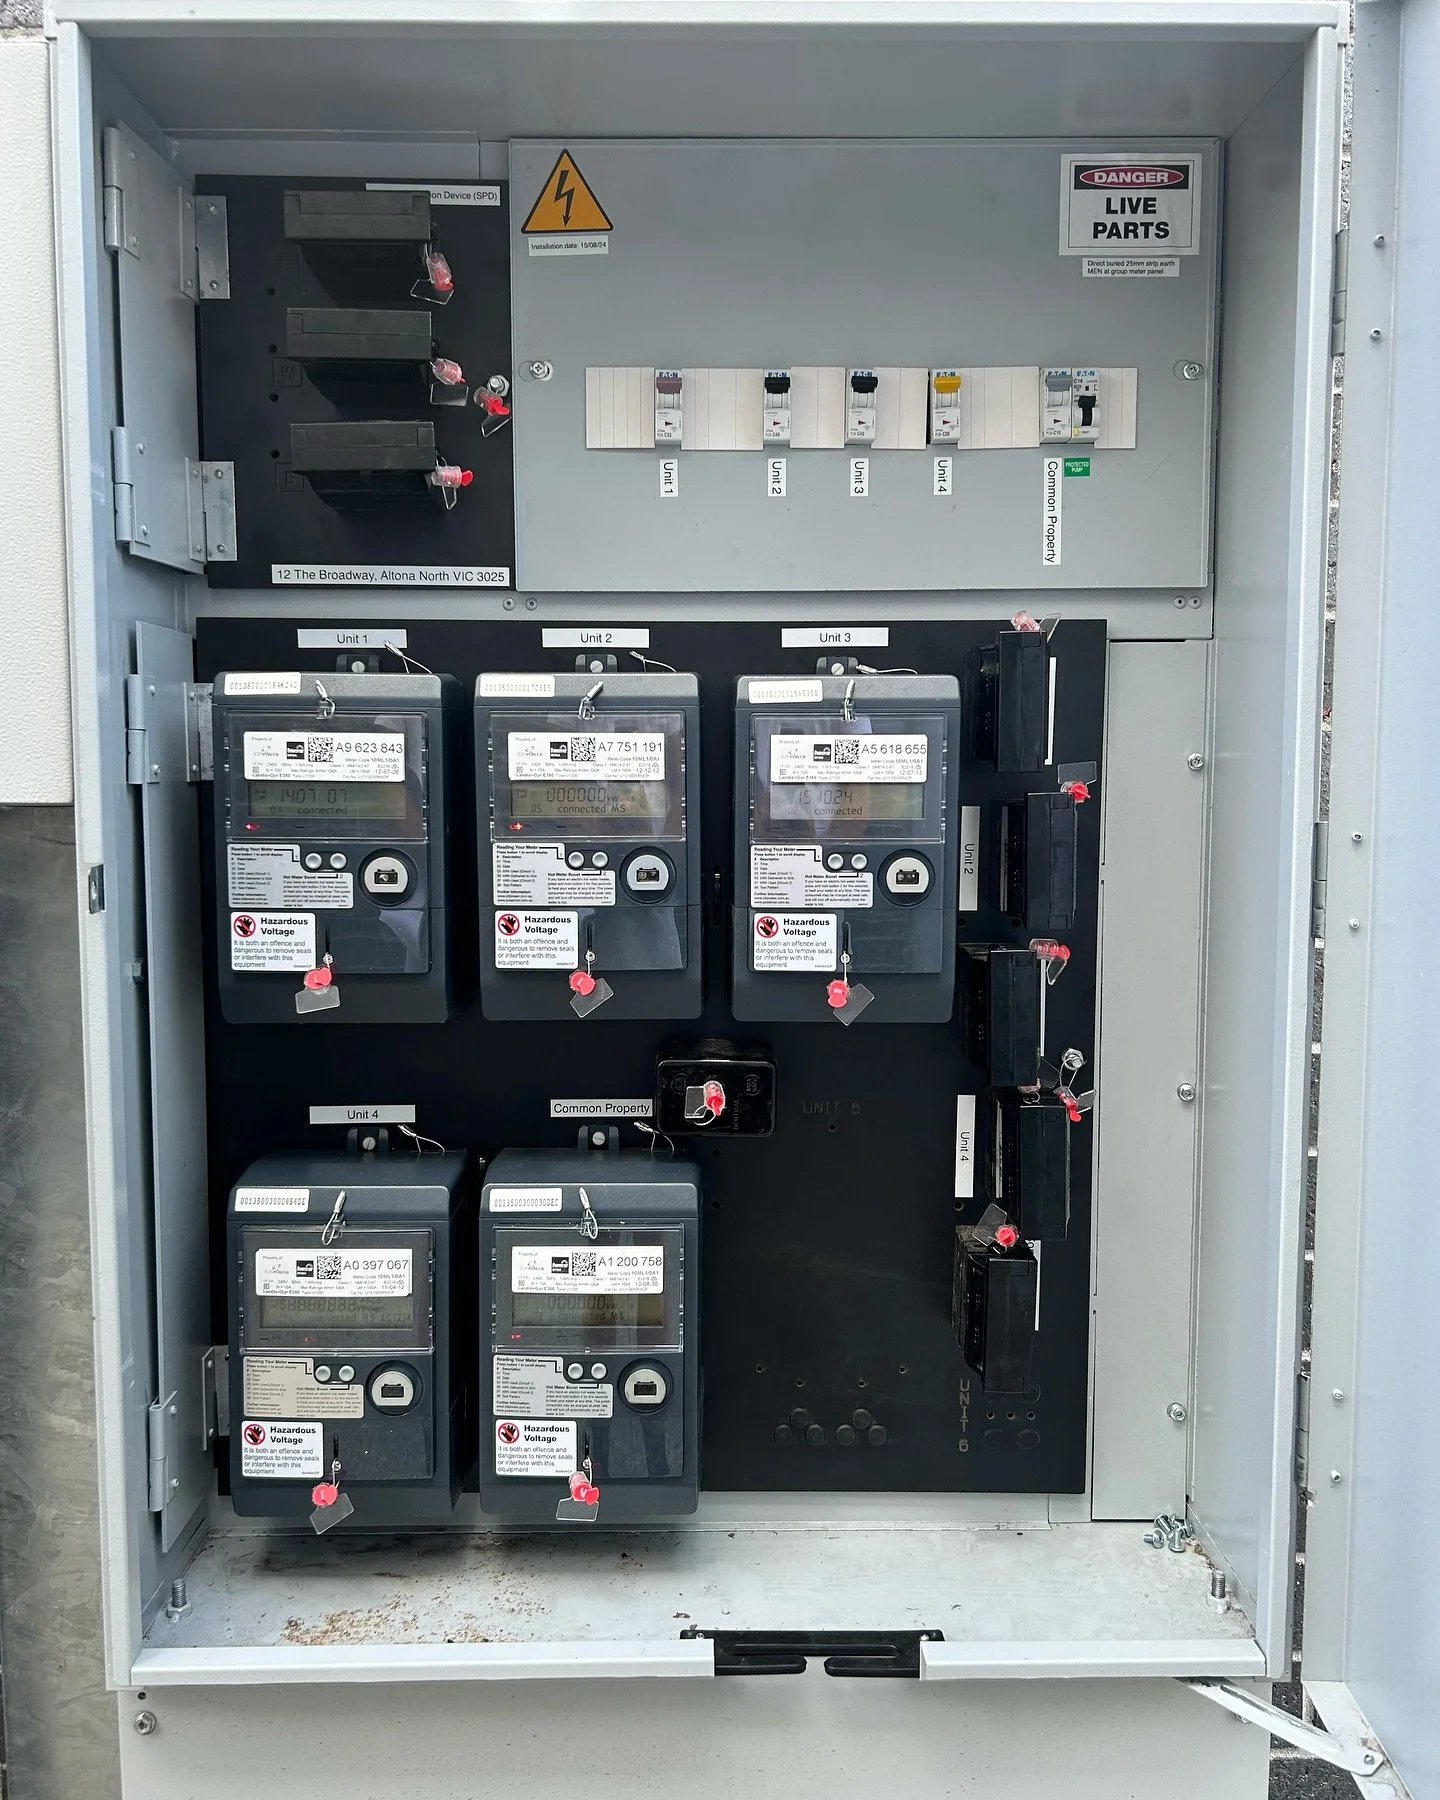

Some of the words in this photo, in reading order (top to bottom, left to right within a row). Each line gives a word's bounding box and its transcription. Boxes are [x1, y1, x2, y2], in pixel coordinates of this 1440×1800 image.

[1094, 172, 1168, 183] DANGER
[474, 192, 497, 201] (SPD)
[1106, 197, 1157, 214] LIVE
[1093, 222, 1170, 239] PARTS
[664, 462, 674, 485] Unit
[772, 461, 782, 484] Unit
[855, 461, 864, 484] Unit
[938, 460, 947, 482] Unit
[1048, 461, 1058, 512] Common
[1045, 516, 1057, 562] Property
[277, 570, 291, 580] 12
[294, 570, 316, 580] The
[319, 570, 378, 583] Broadway,
[380, 570, 415, 581] Altona
[420, 571, 449, 581] North
[453, 571, 473, 582] VIC
[477, 572, 505, 582] 3025
[336, 633, 359, 644] Unit
[362, 633, 368, 644] 1
[580, 632, 602, 644] Unit
[605, 632, 612, 644] 2
[819, 632, 841, 644] Unit
[844, 632, 851, 644] 3
[335, 743, 352, 752] A9
[355, 743, 377, 753] 623
[381, 743, 403, 754] 843
[598, 742, 614, 752] A7
[618, 742, 638, 752] 751
[642, 742, 662, 752] 191
[861, 744, 878, 754] A5
[880, 744, 902, 754] 618
[905, 744, 927, 754] 655
[297, 806, 347, 815] connected
[814, 807, 862, 816] connected
[964, 843, 975, 866] Unit
[260, 928, 295, 936] Voltage
[525, 926, 558, 935] Voltage
[783, 928, 816, 937] Voltage
[554, 1104, 601, 1113] Common
[606, 1104, 649, 1114] Property
[802, 1101, 840, 1115] UNIT
[348, 1110, 368, 1119] Unit
[372, 1110, 378, 1118] 4
[959, 1131, 970, 1153] Unit
[960, 1153, 969, 1161] 4
[343, 1260, 359, 1270] A0
[362, 1260, 383, 1270] 397
[387, 1260, 409, 1269] 067
[598, 1257, 613, 1267] A1
[617, 1257, 638, 1266] 200
[642, 1257, 662, 1266] 758
[959, 1378, 970, 1433] UNIT
[270, 1436, 303, 1445] Voltage
[524, 1435, 557, 1443] Voltage
